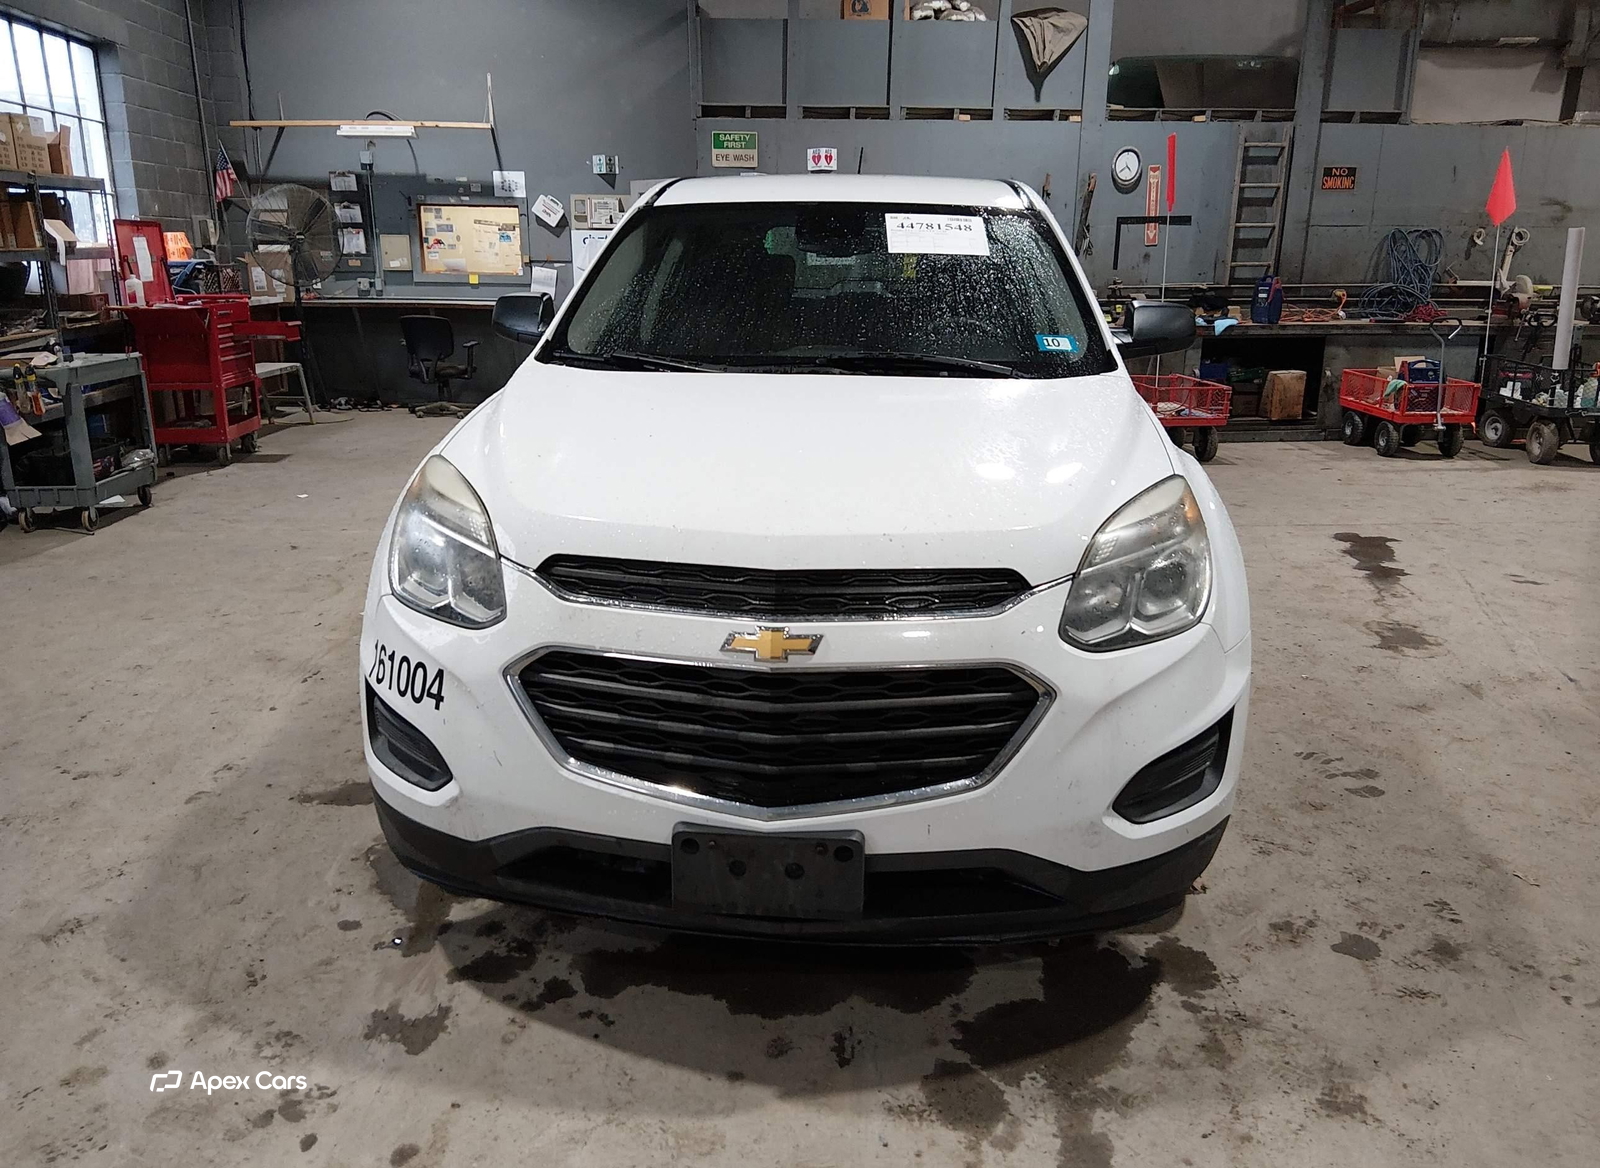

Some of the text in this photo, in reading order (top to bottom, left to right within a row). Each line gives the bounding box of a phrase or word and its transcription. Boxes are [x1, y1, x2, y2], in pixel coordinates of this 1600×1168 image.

[719, 133, 750, 141] SAFETY
[723, 141, 747, 149] FIRST
[715, 153, 755, 162] EYE WASH
[1332, 168, 1348, 176] NO
[1322, 176, 1355, 189] SMOKING
[896, 222, 973, 232] 44781548
[1043, 338, 1061, 348] 10
